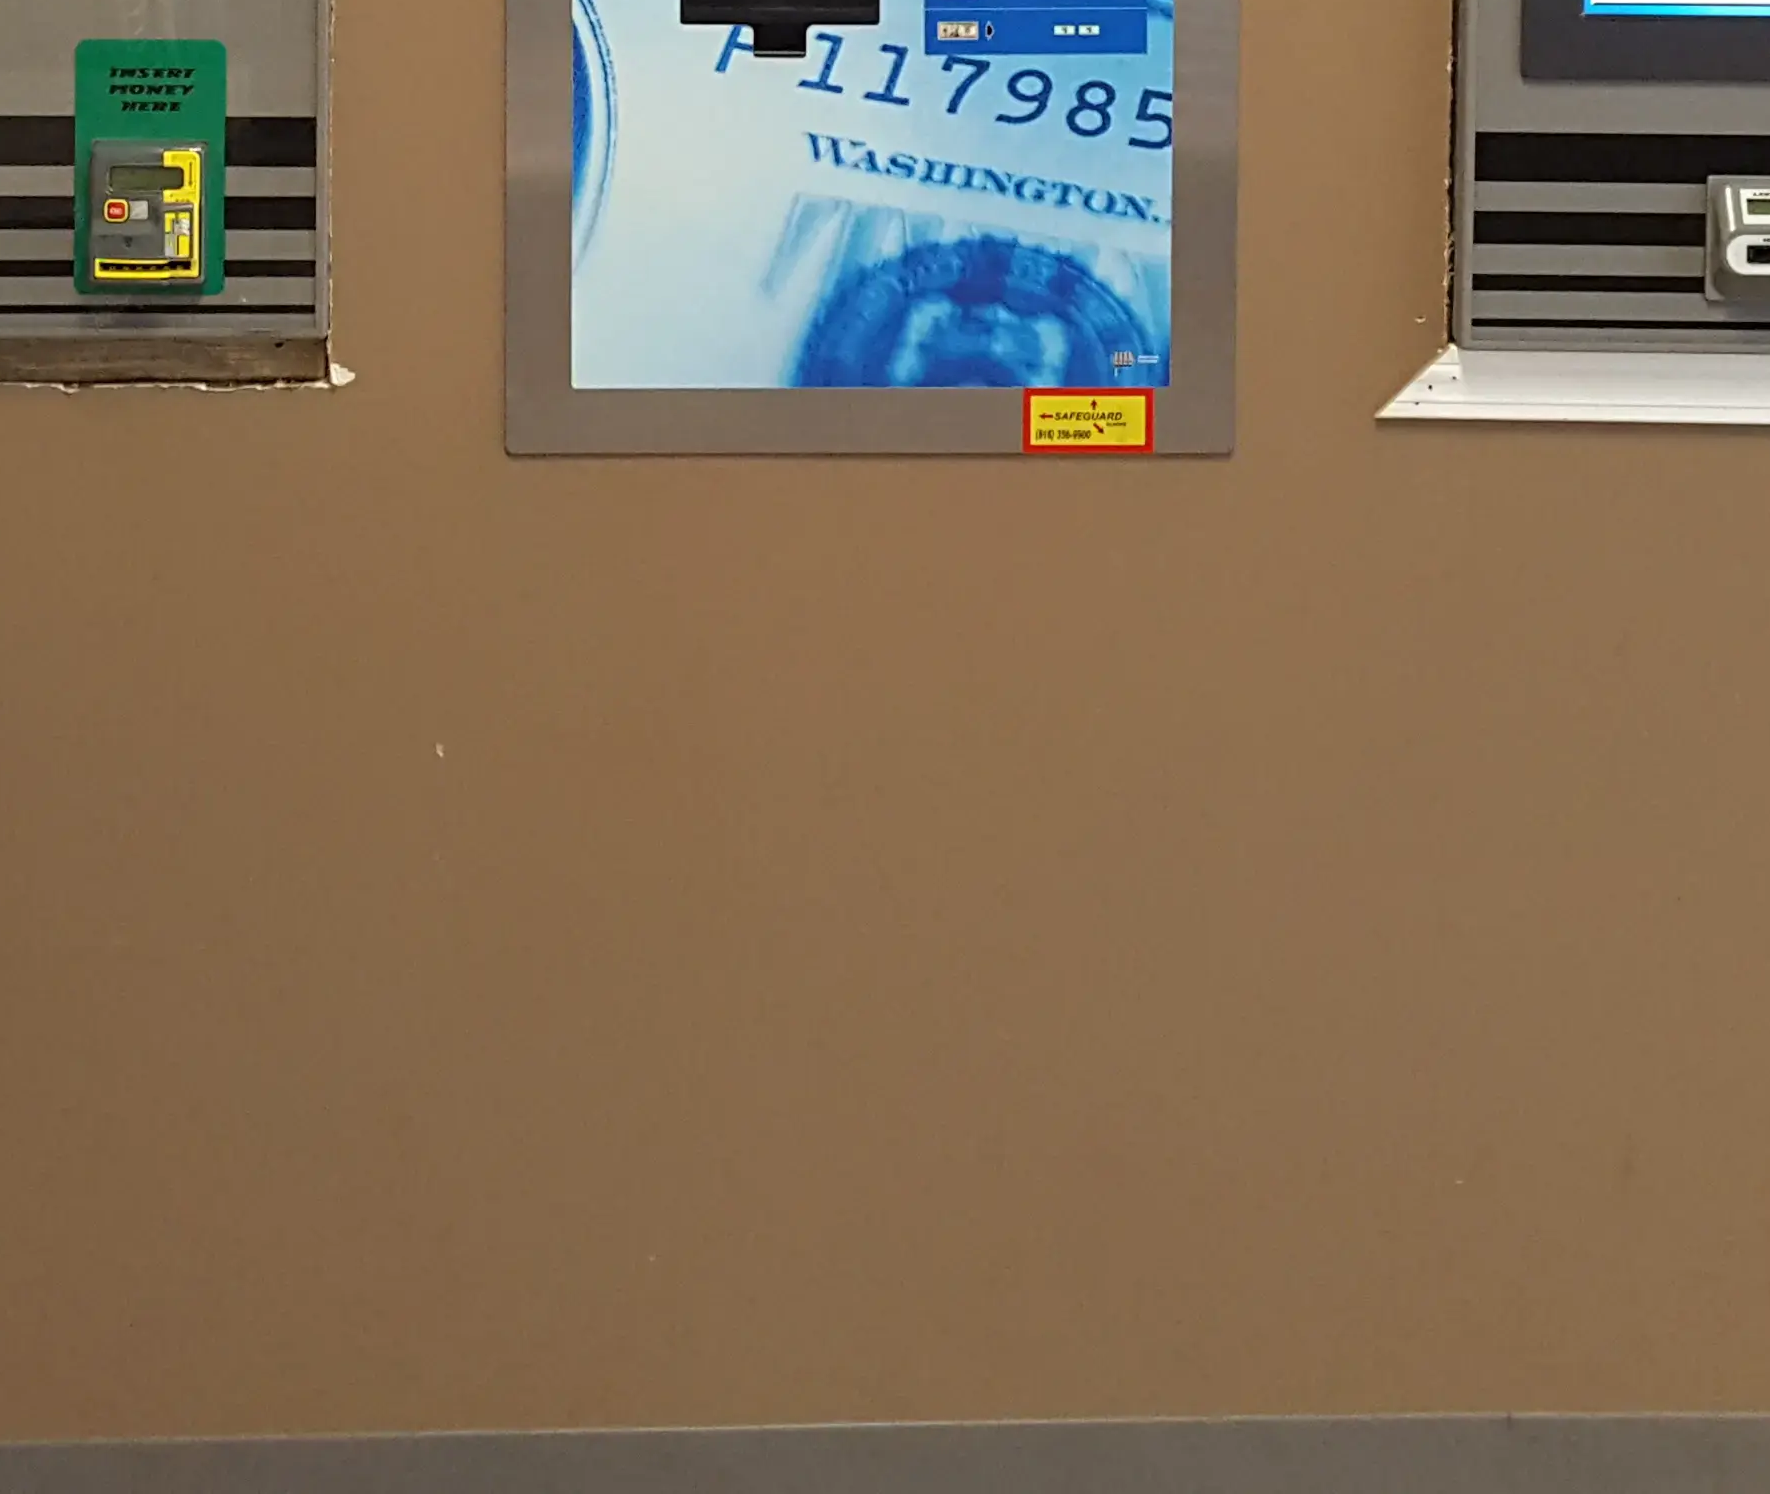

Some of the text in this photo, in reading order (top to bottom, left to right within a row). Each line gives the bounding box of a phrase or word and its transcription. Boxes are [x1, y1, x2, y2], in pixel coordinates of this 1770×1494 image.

[109, 67, 196, 79] INSERT
[109, 85, 194, 95] MONEY
[121, 102, 181, 112] HERE
[803, 131, 1160, 224] WASHINGTON.
[1053, 412, 1122, 421] SAFEGUARD
